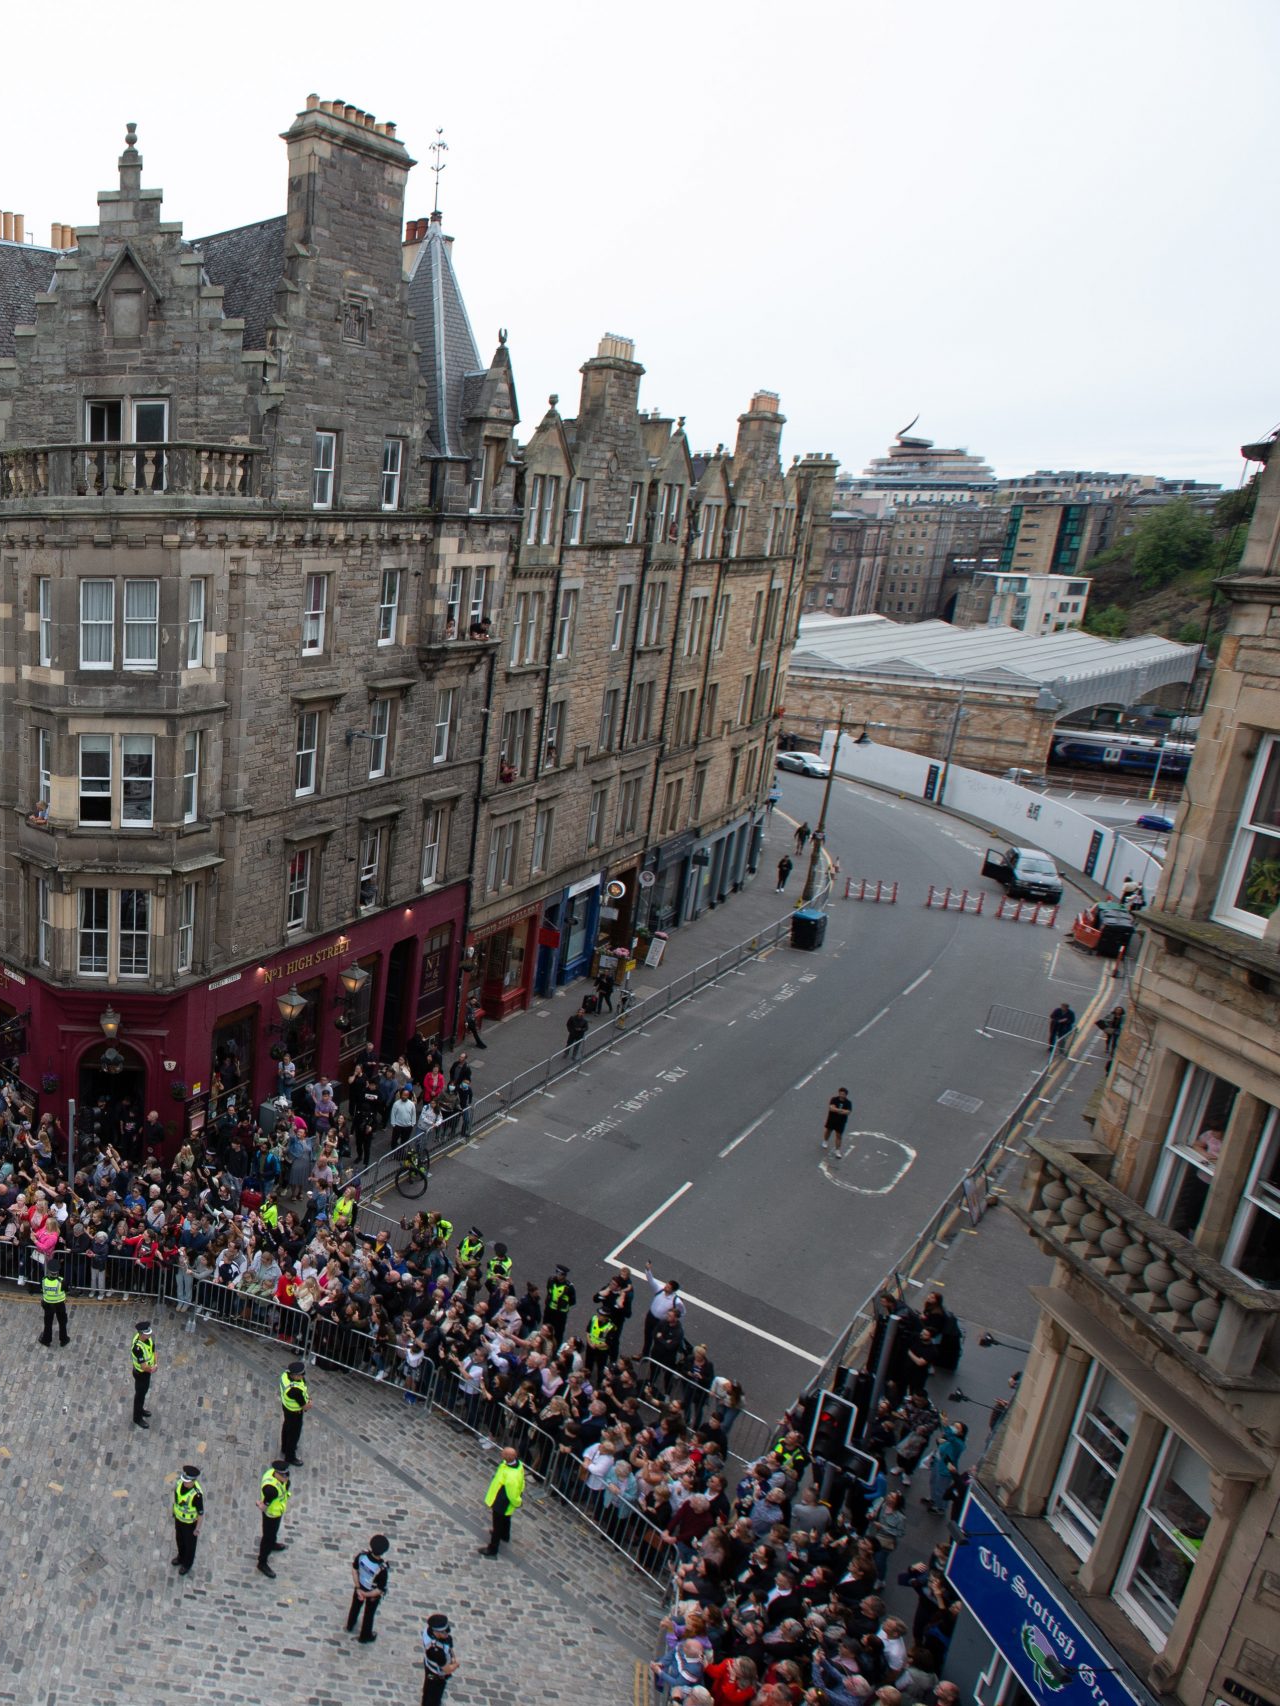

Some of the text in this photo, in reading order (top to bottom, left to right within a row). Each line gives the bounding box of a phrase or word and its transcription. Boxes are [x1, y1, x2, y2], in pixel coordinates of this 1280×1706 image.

[286, 953, 314, 975] HIGH
[315, 940, 351, 965] STREET
[662, 1065, 689, 1083] ONLY
[979, 1546, 1009, 1582] The
[1010, 1575, 1076, 1660] Scottish
